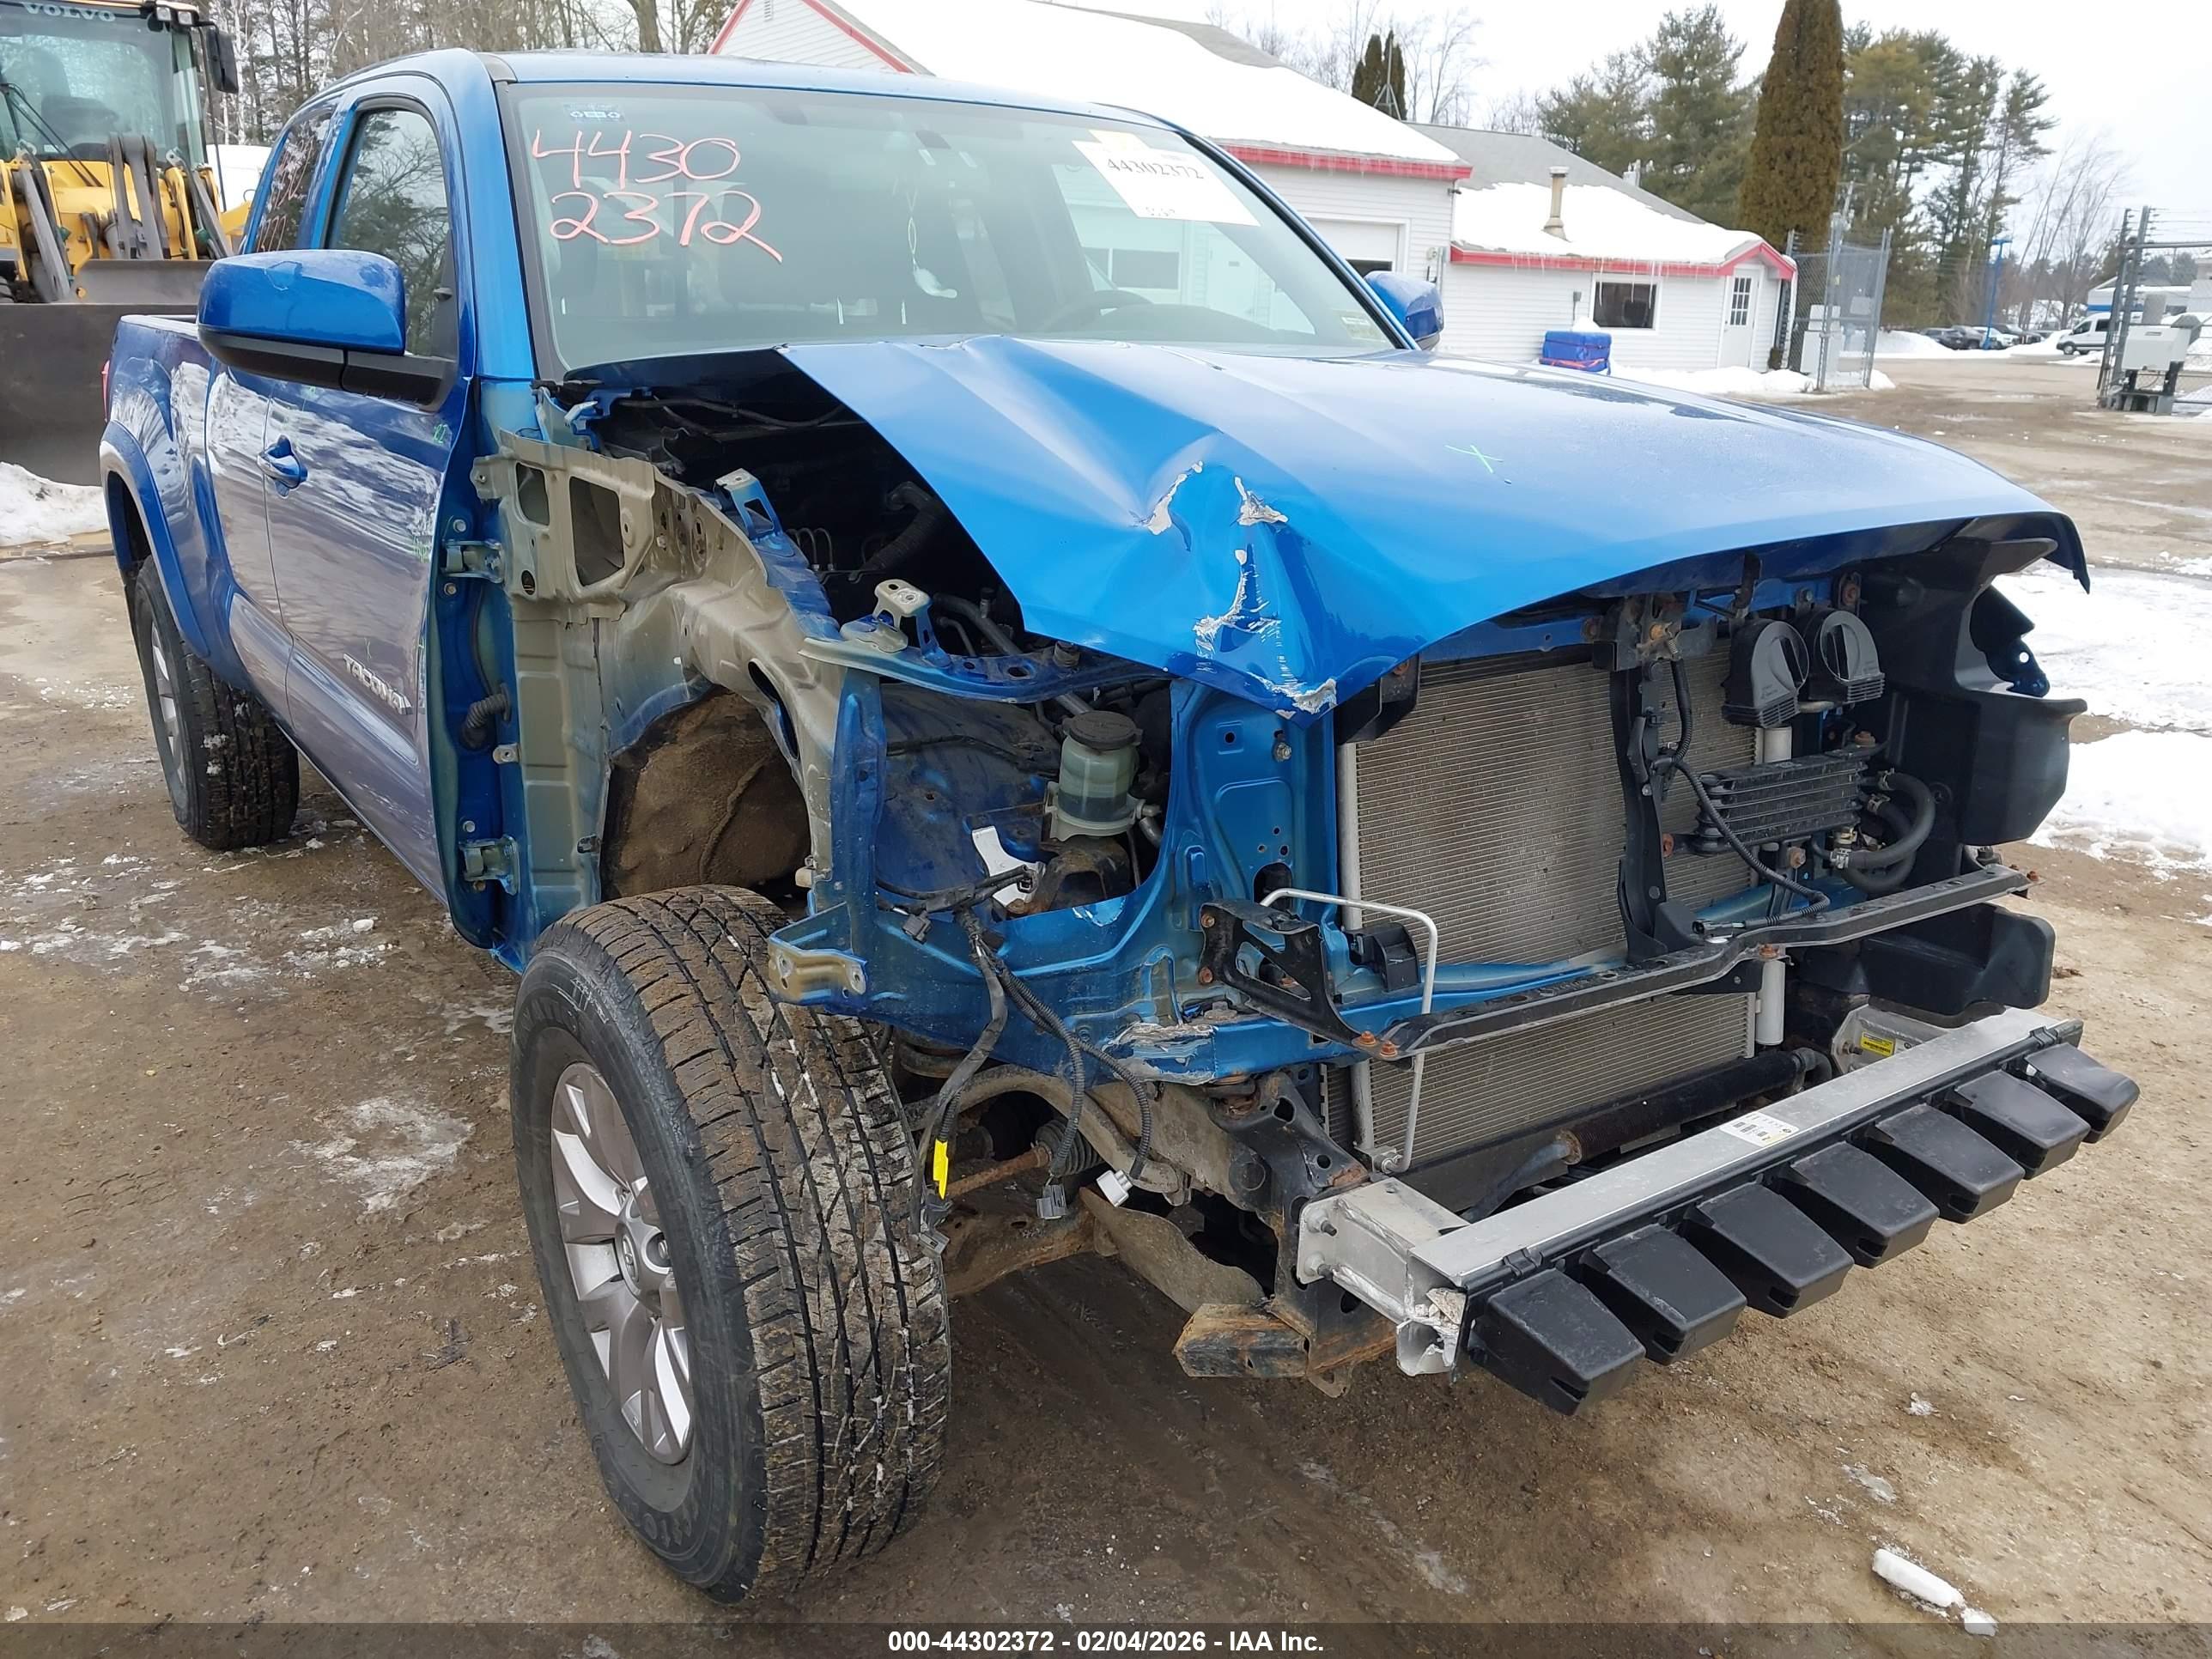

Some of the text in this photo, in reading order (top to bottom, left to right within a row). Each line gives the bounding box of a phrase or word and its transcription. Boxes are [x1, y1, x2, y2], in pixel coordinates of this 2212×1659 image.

[21, 2, 116, 21] VOLVO
[532, 129, 741, 190] 4430
[550, 191, 783, 264] 2372
[343, 653, 412, 714] TACOMA
